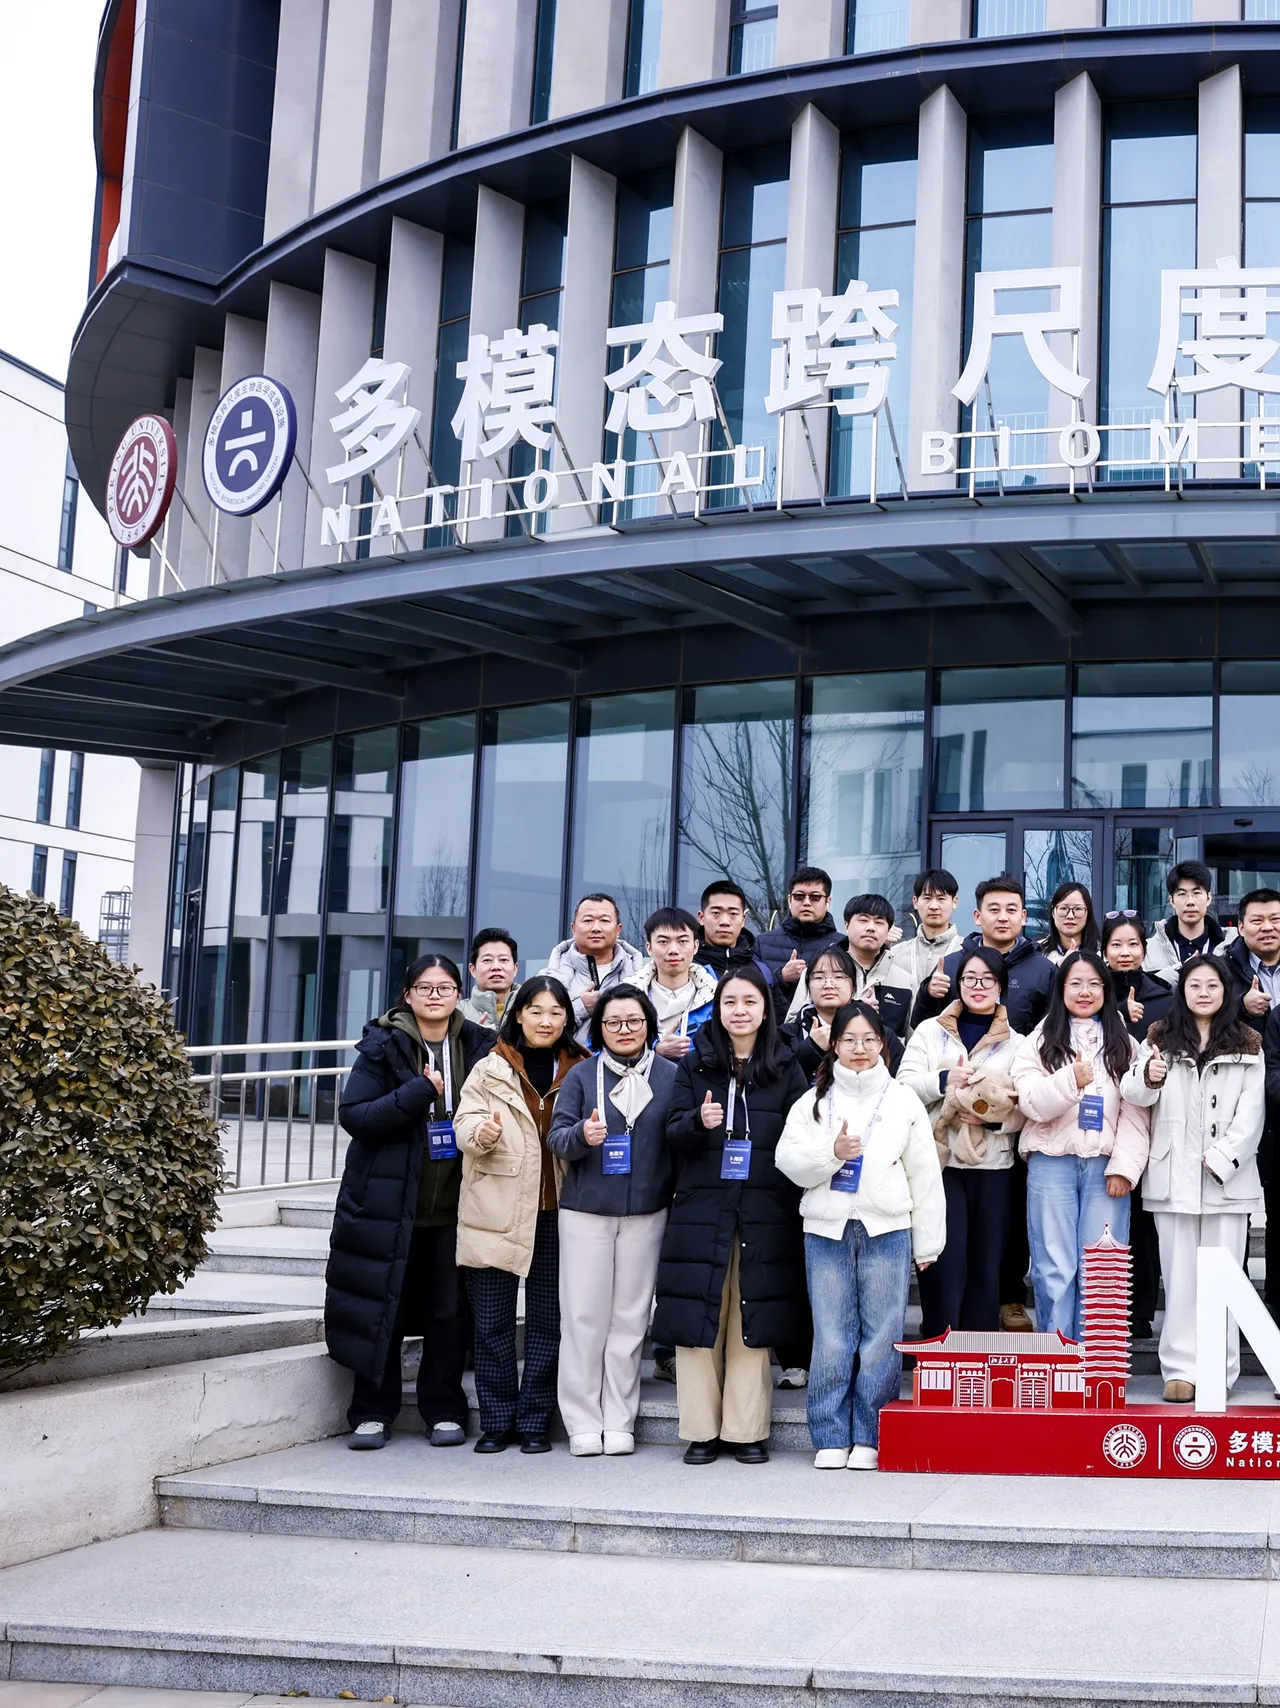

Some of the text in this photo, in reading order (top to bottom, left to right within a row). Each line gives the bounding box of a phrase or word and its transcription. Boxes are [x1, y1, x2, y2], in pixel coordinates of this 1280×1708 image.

[108, 419, 167, 514] PEKING UNIVERSITY
[321, 445, 767, 547] NATIONAL
